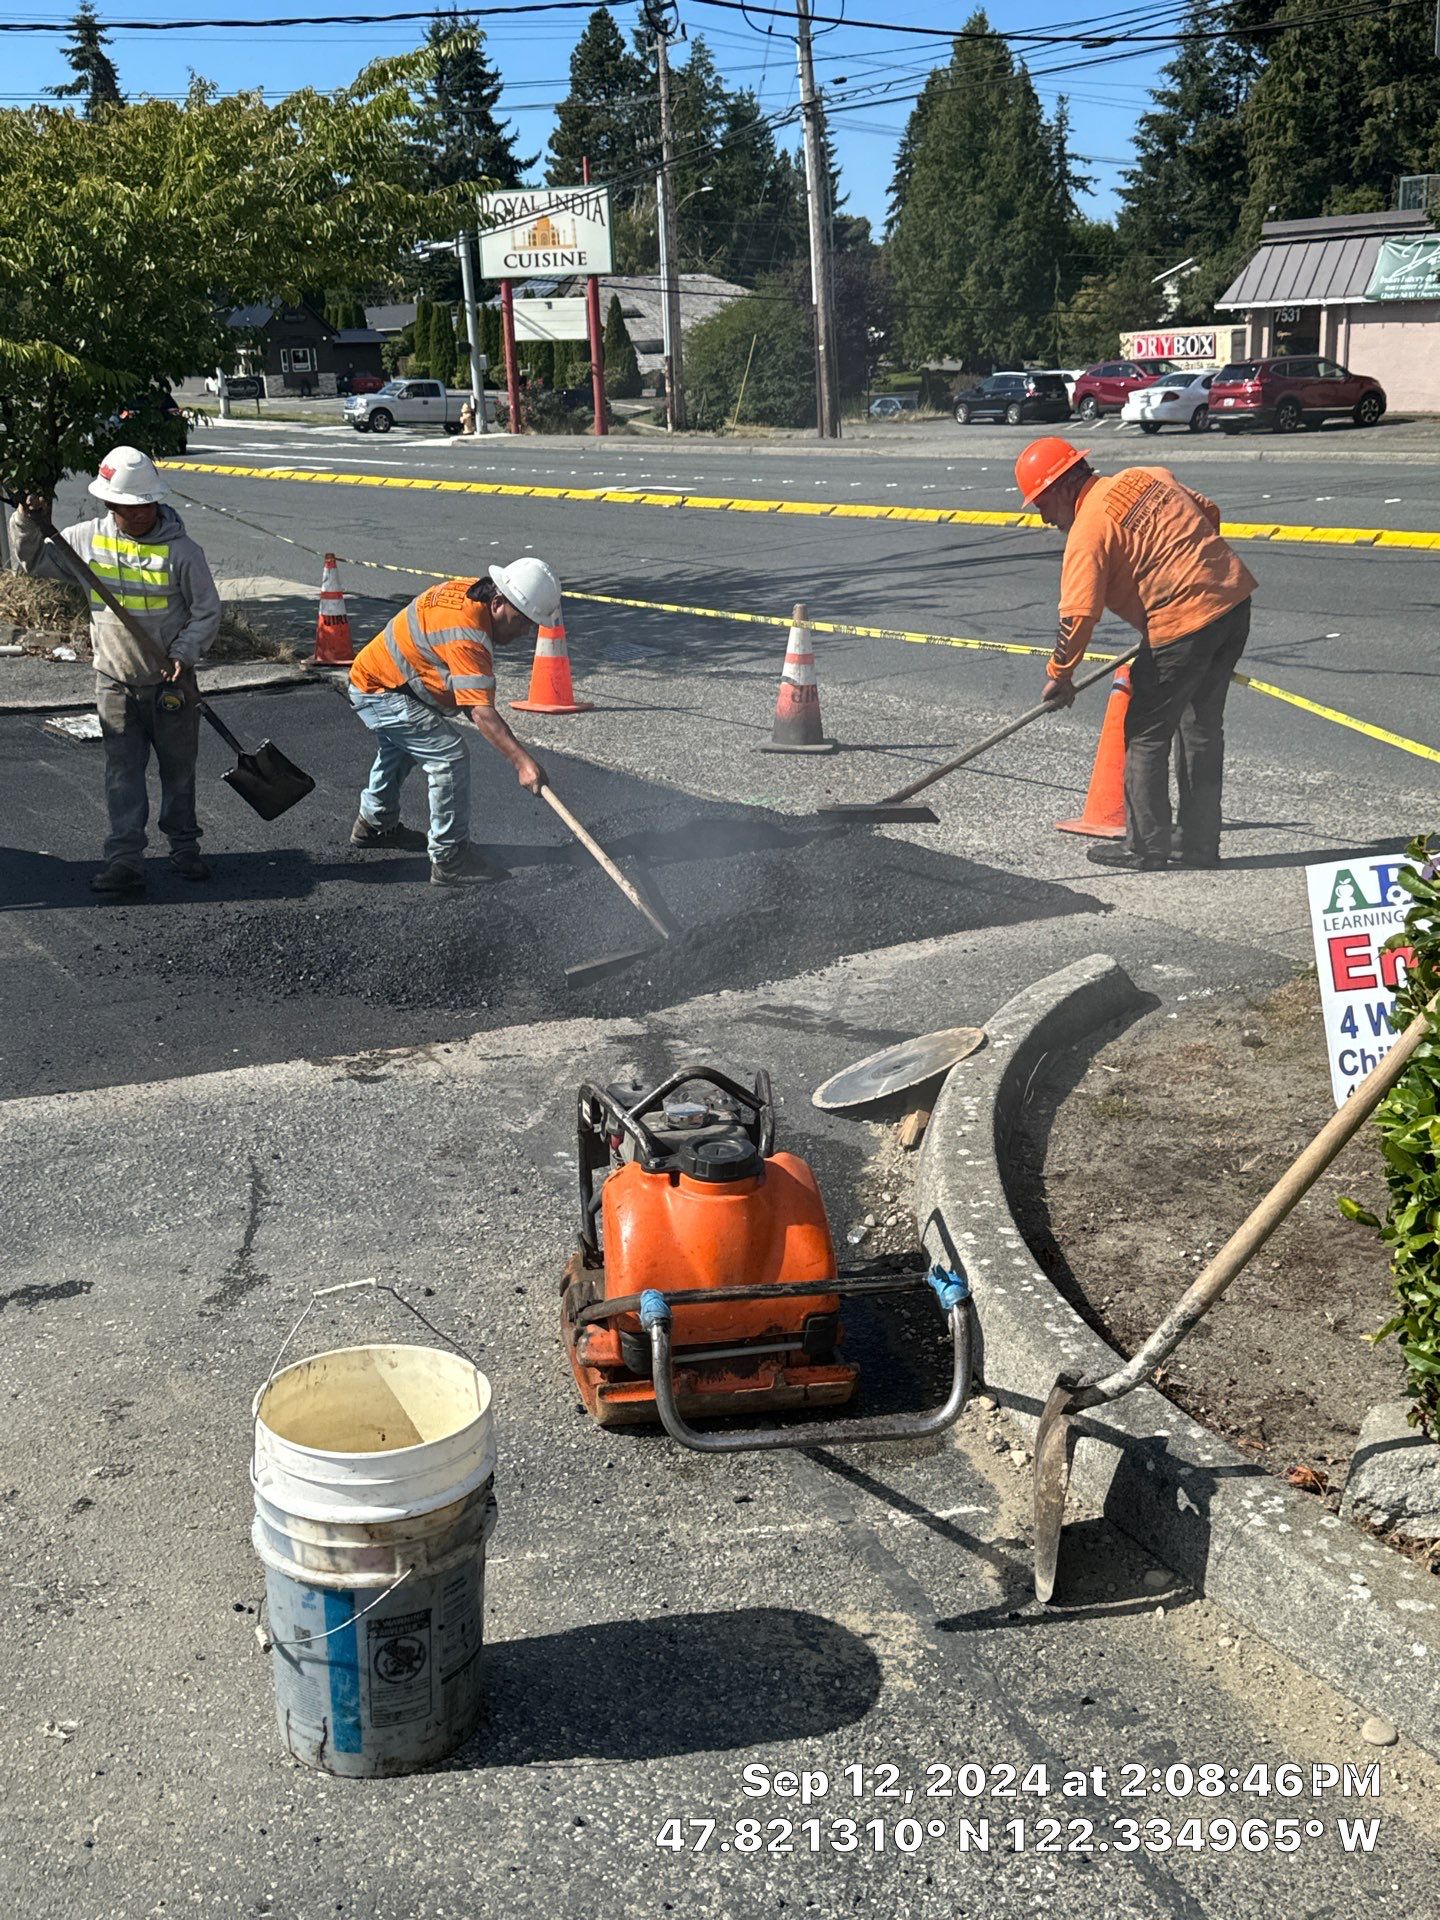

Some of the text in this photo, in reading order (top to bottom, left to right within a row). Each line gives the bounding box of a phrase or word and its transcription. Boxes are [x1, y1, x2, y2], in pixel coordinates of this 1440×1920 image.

[548, 192, 606, 227] INDIA
[503, 251, 588, 269] CUISINE
[1275, 307, 1301, 323] 7531
[1323, 909, 1405, 932] LEARNING
[1340, 1004, 1359, 1040] 4
